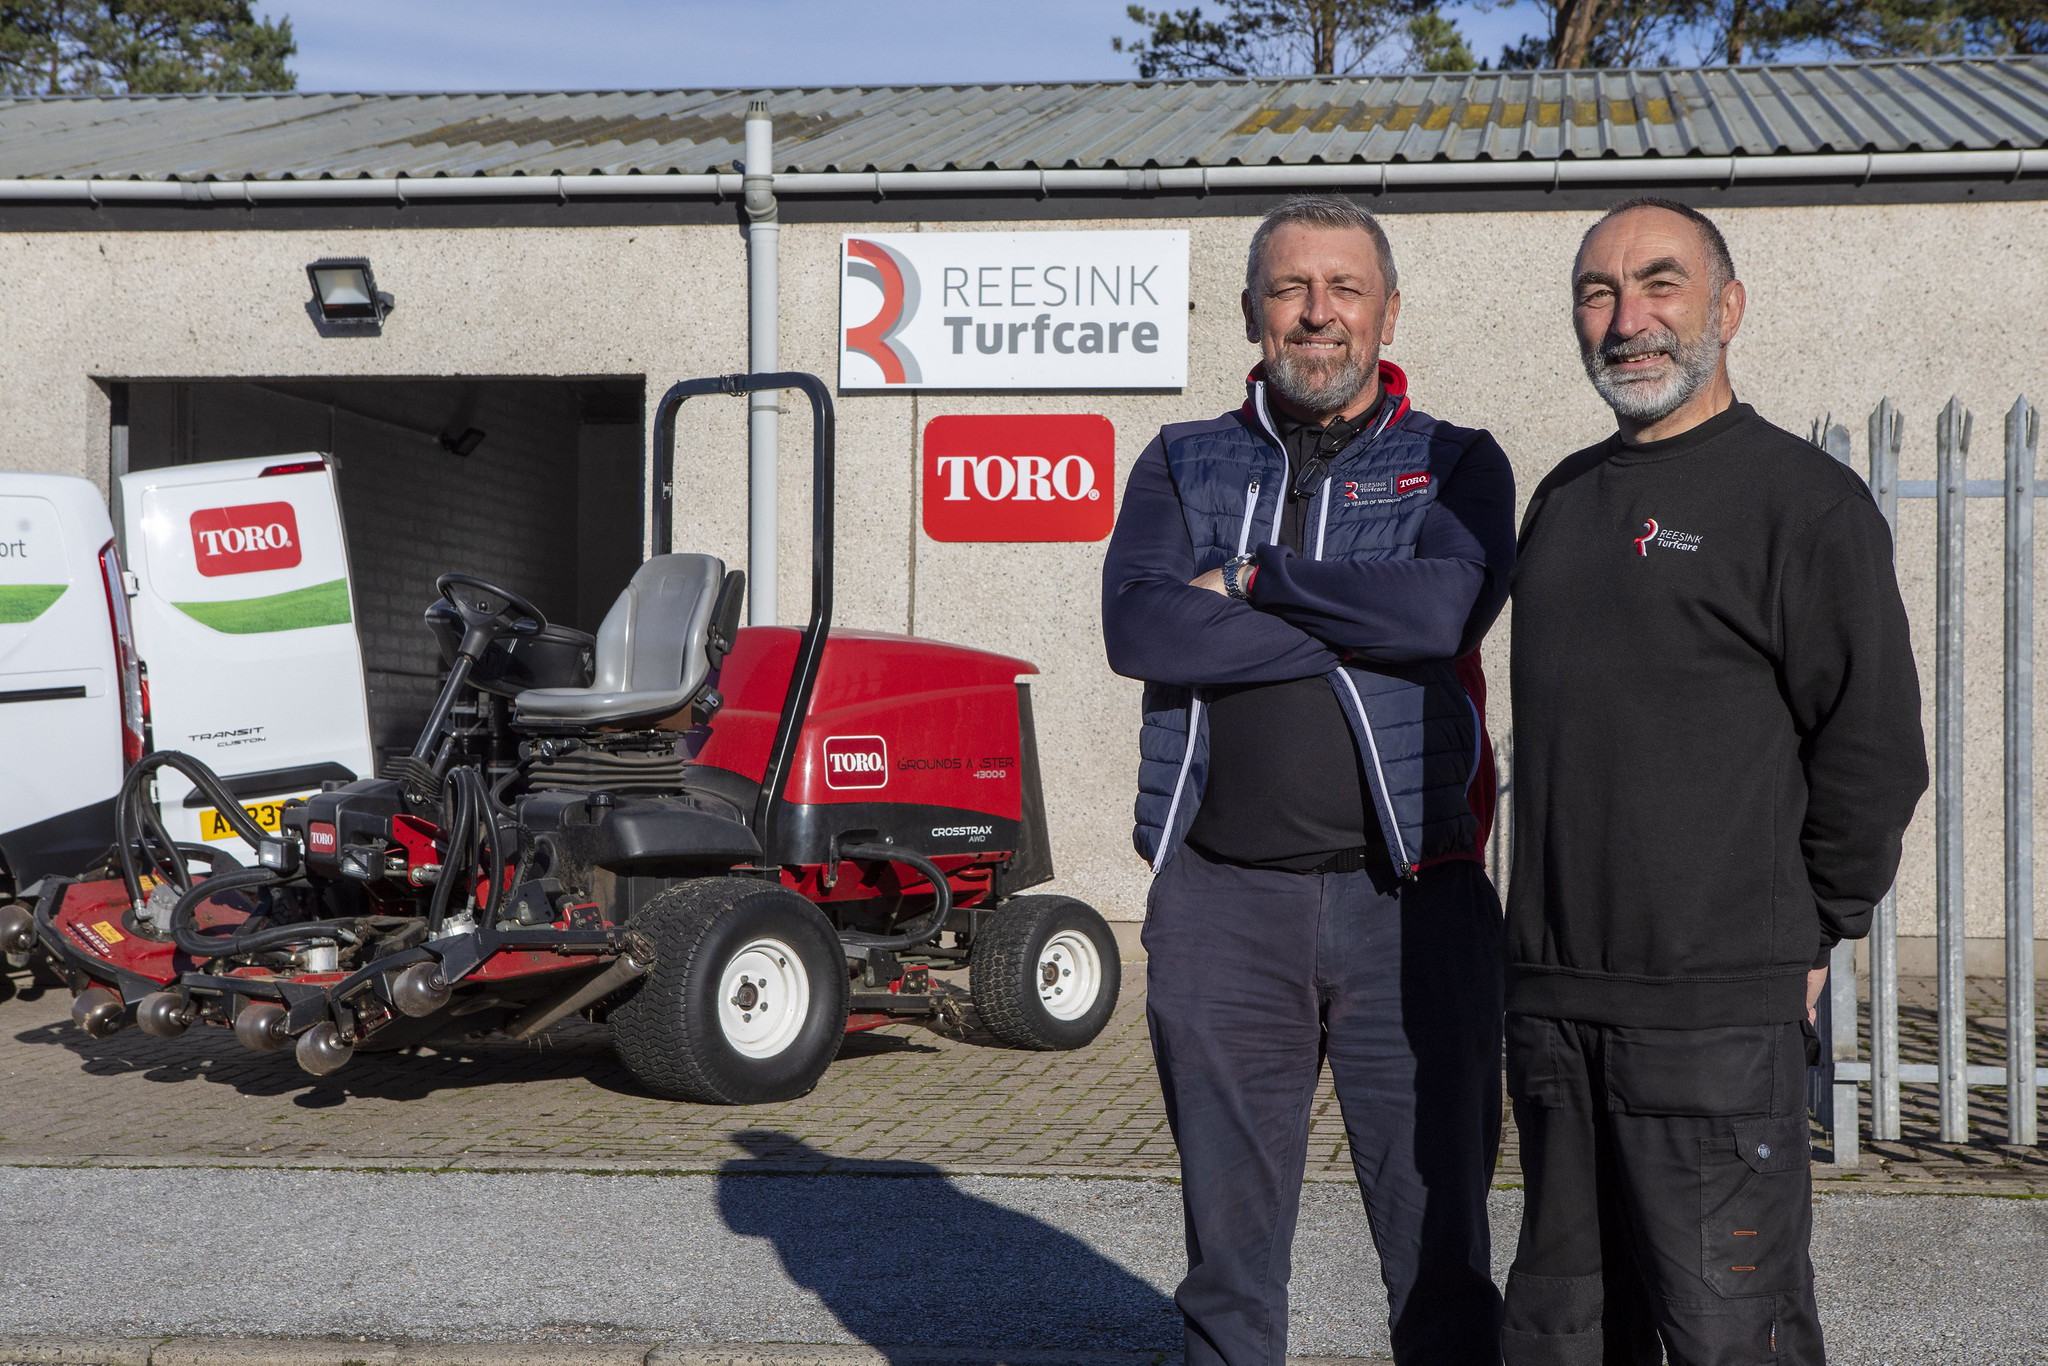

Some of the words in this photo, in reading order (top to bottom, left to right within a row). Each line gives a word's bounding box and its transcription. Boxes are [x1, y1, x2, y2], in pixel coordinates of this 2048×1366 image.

[943, 265, 1159, 307] REESINK
[943, 313, 1159, 355] Turfcare
[1659, 529, 1703, 544] REESINK
[1657, 537, 1699, 552] Turfcare
[188, 726, 264, 741] TRANSIT
[217, 737, 267, 747] CUSTOM
[311, 831, 333, 846] TORO
[931, 825, 993, 837] CROSSTRAX
[968, 835, 986, 843] AWD
